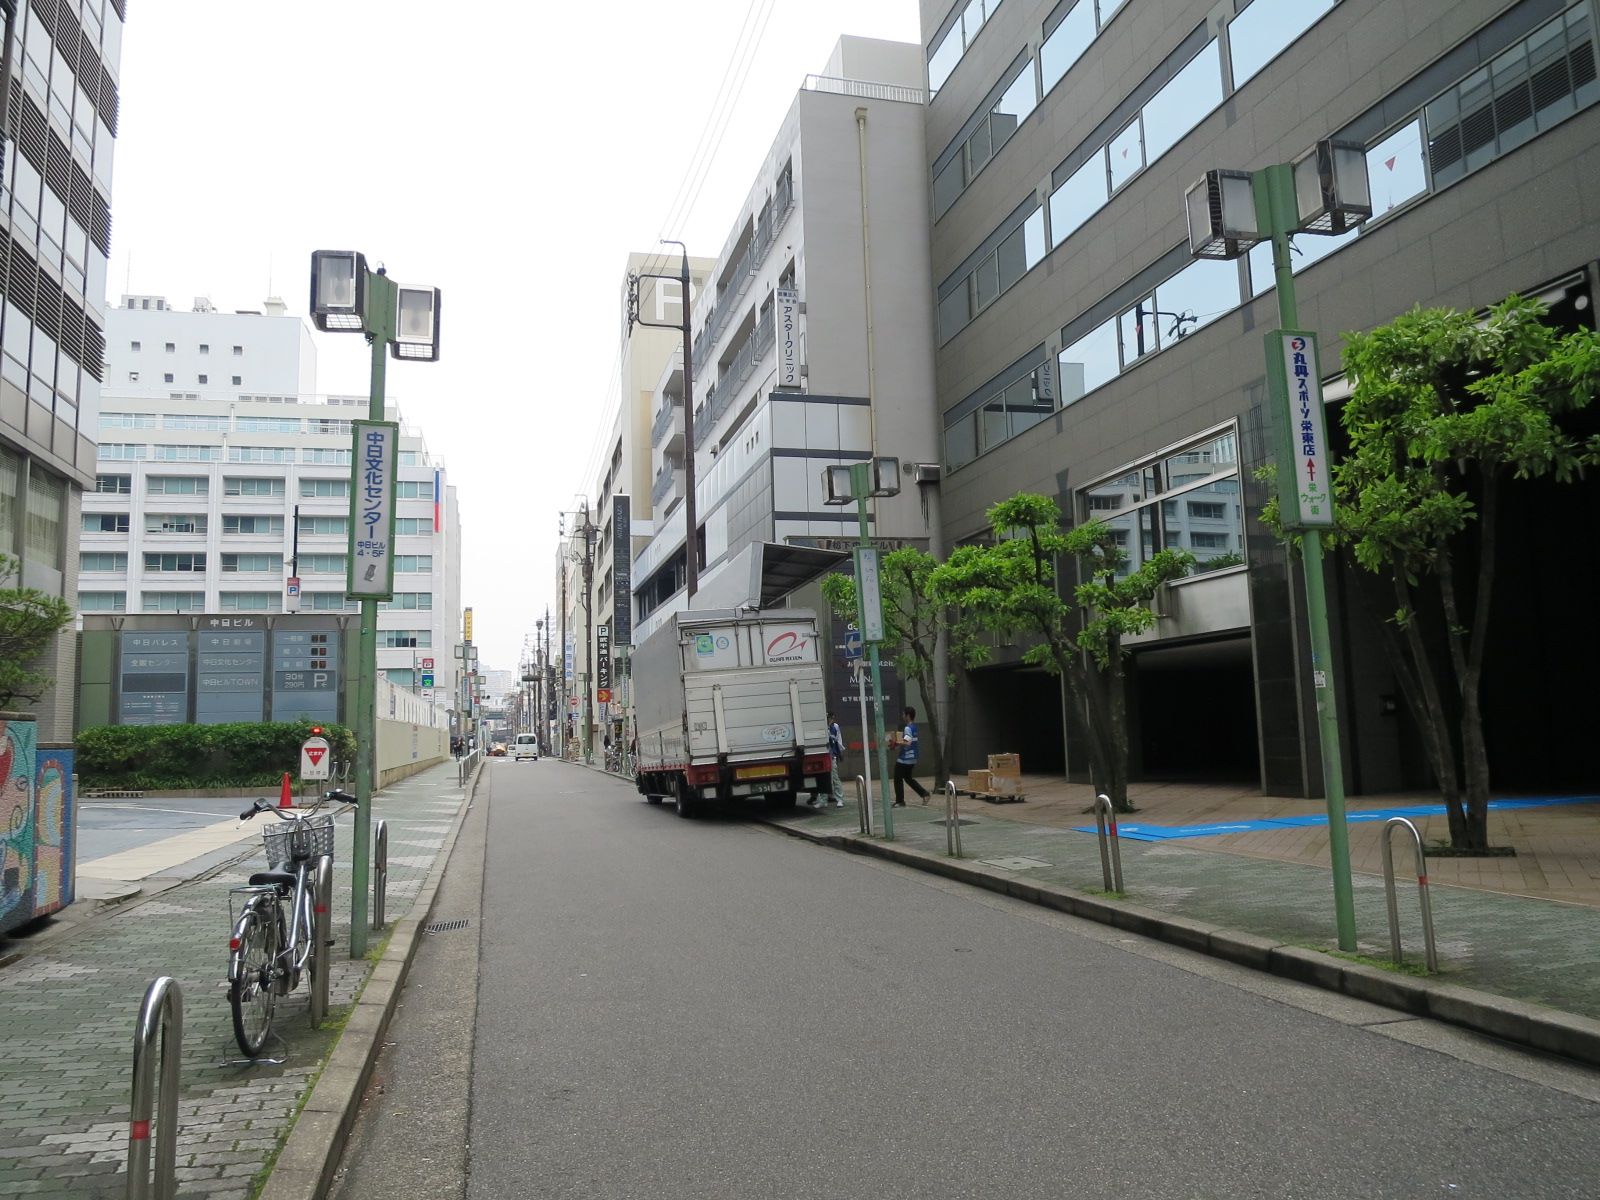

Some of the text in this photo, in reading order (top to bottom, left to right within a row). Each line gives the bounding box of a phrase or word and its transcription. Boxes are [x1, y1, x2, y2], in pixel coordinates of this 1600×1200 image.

[783, 306, 794, 383] アスタークリニック
[364, 431, 385, 539] 中日文化センター
[357, 541, 386, 549] 中日ビル
[289, 586, 297, 594] P
[210, 618, 254, 627] 中日ビル
[600, 627, 607, 636] P
[132, 639, 178, 647] 中日パレス
[314, 673, 328, 688] P
